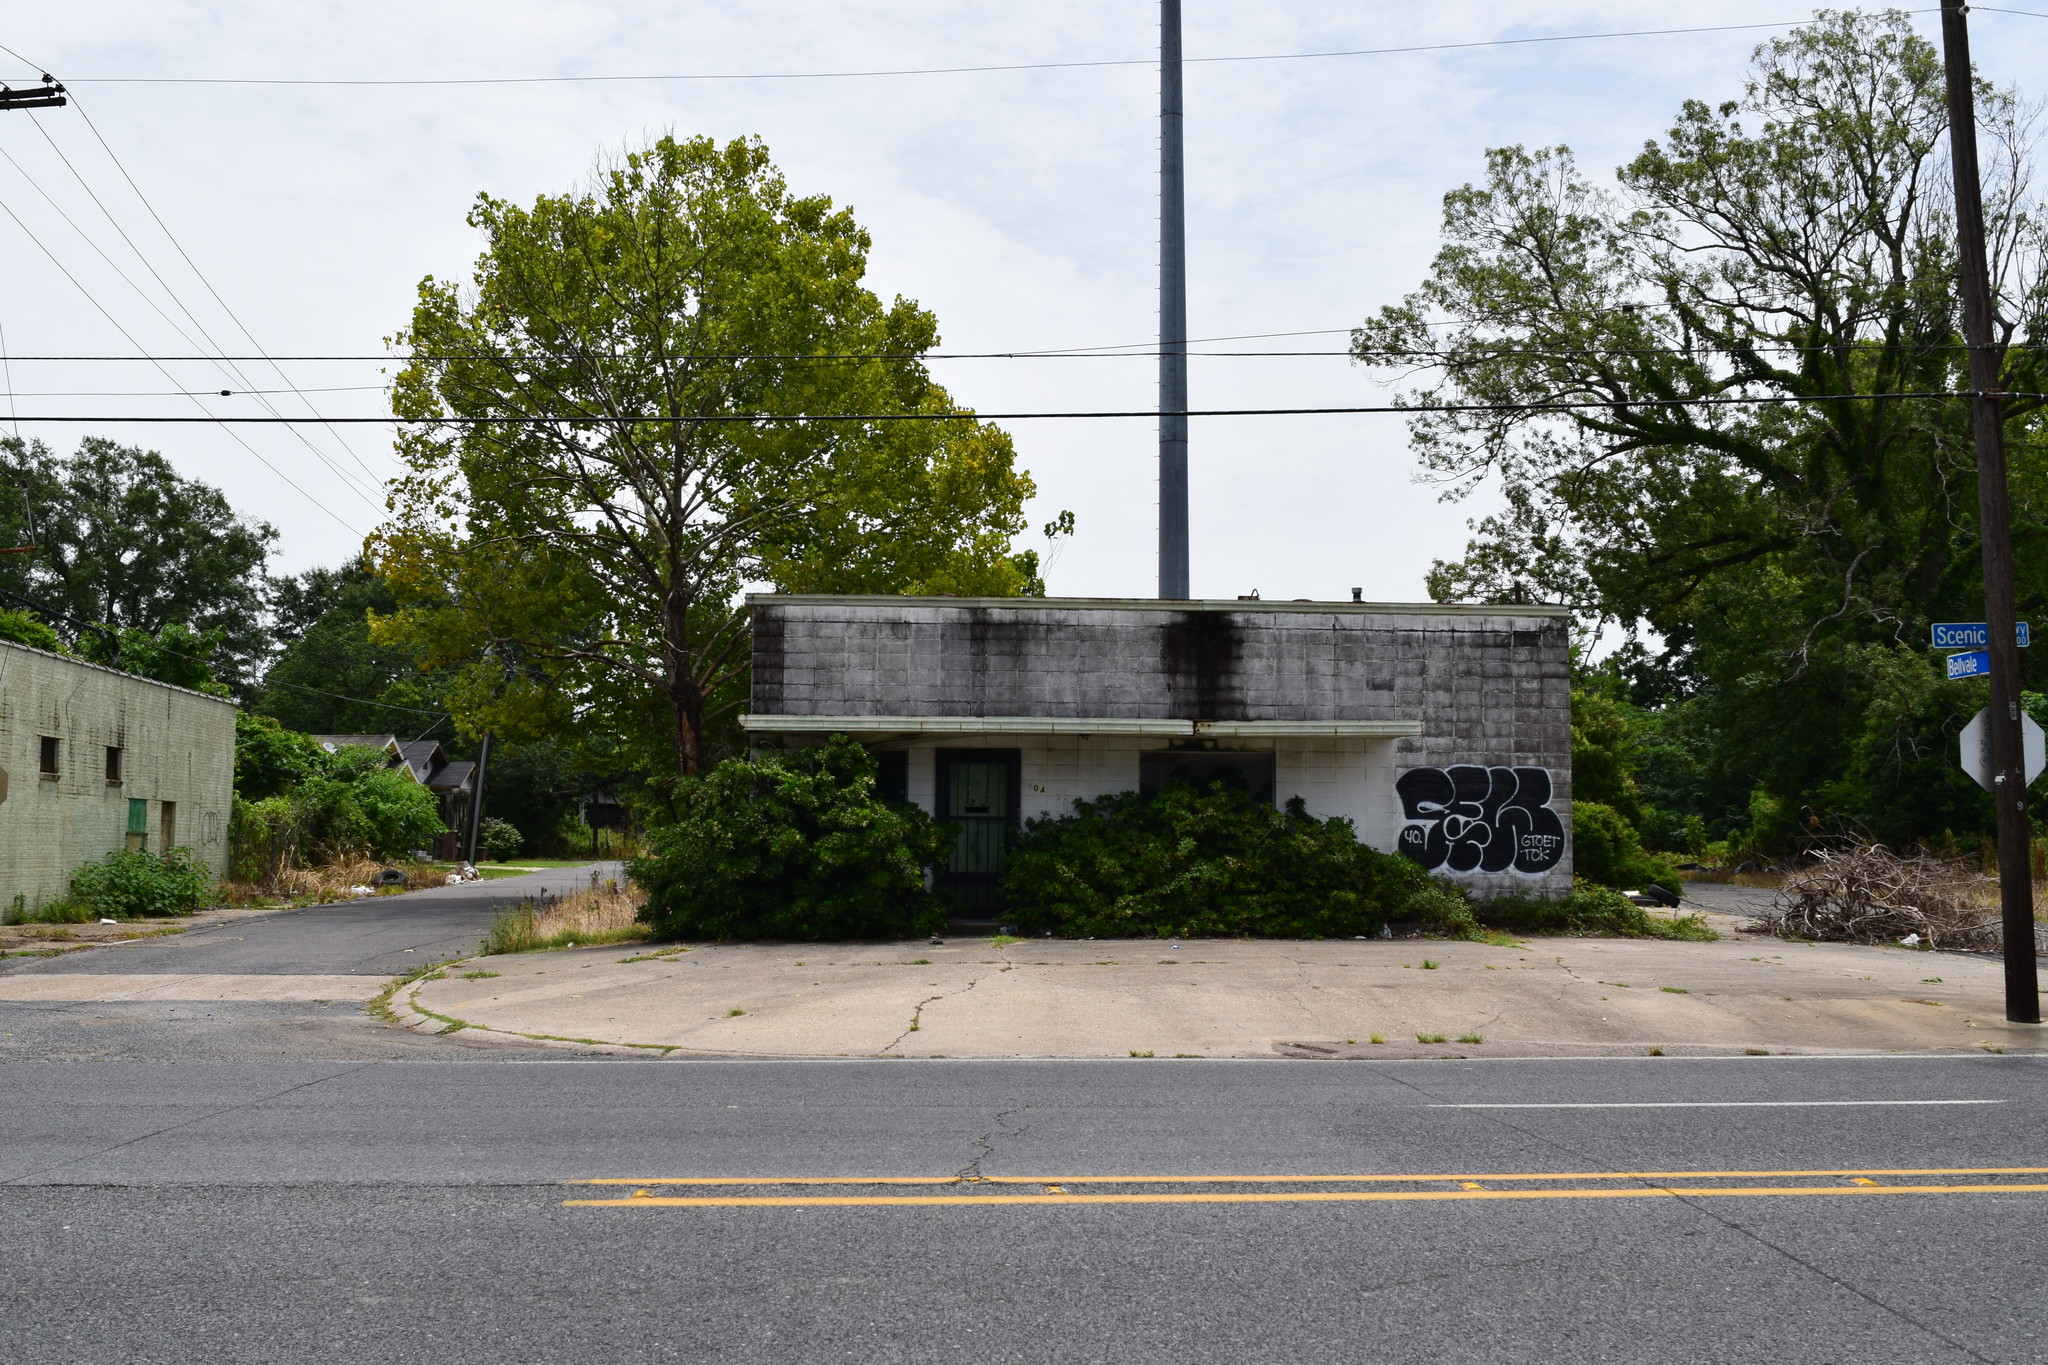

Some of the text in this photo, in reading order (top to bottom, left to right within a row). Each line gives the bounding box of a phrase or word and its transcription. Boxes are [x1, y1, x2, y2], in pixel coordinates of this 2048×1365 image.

[1937, 626, 1986, 645] Scenic
[1949, 656, 1978, 676] Bellvale
[2017, 801, 2024, 811] 9
[1520, 847, 1549, 862] TCK
